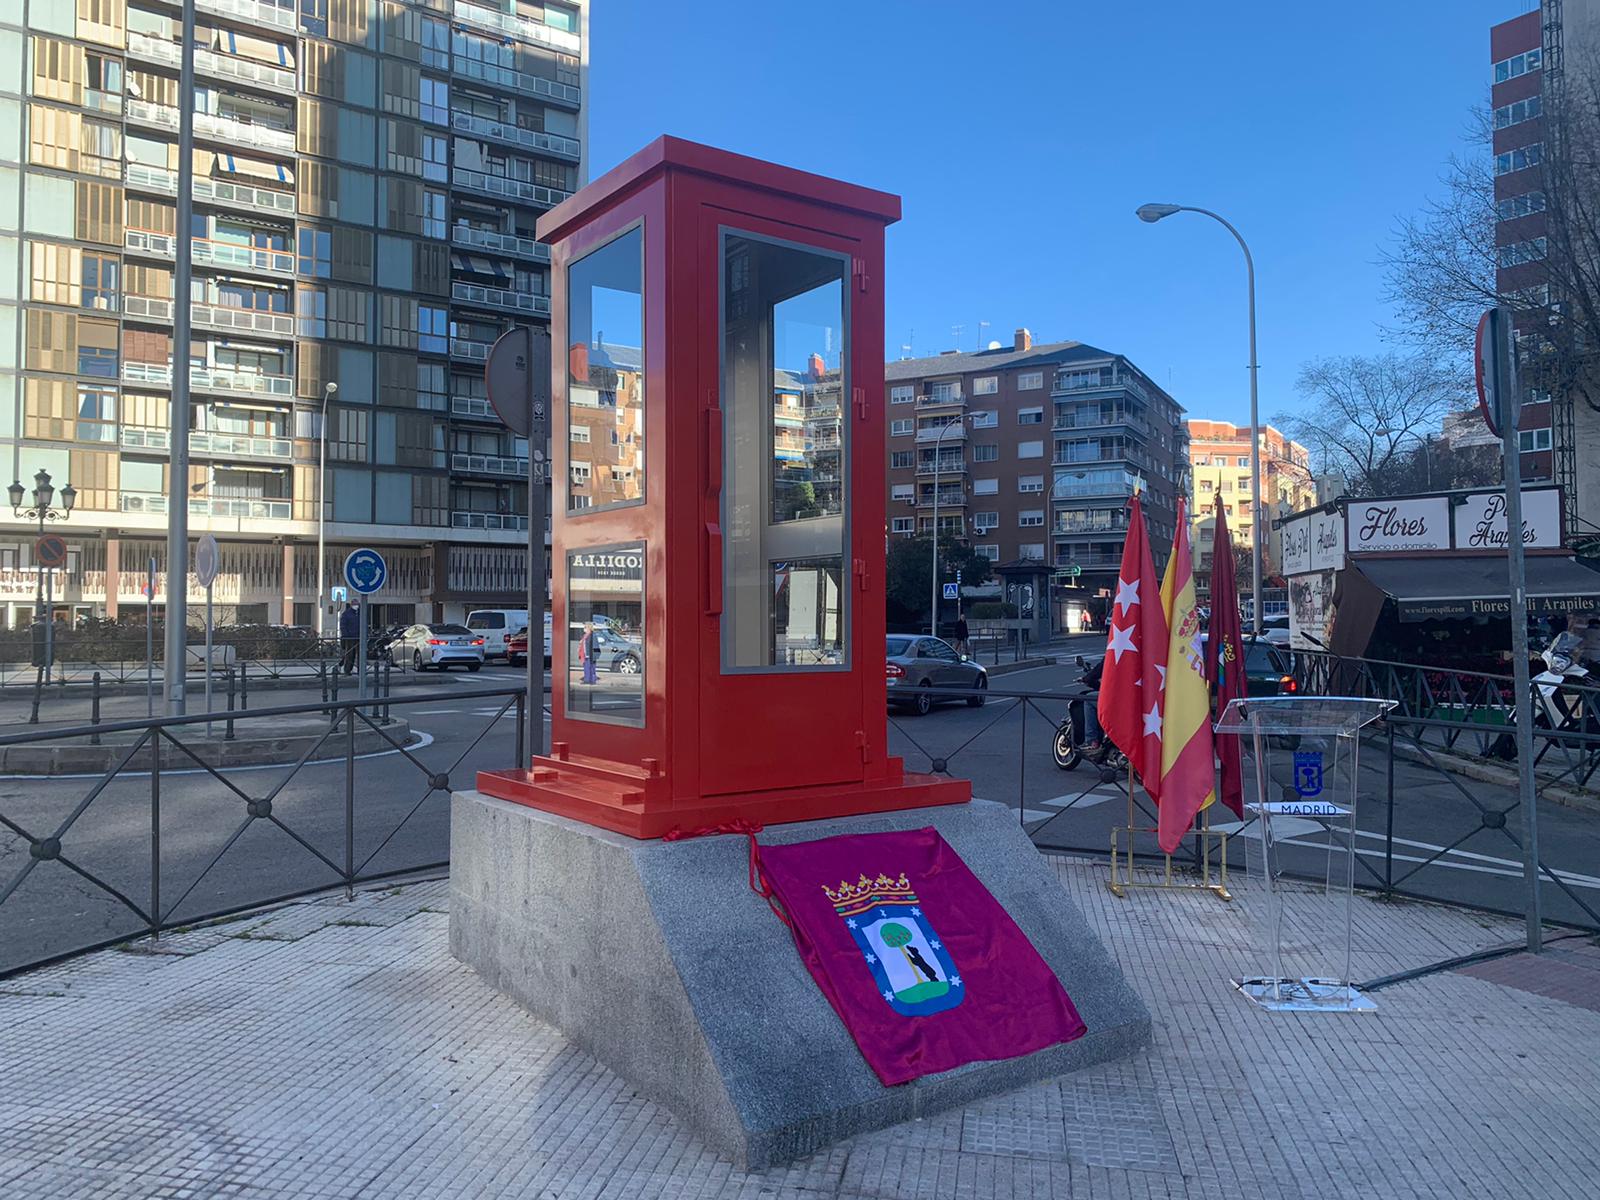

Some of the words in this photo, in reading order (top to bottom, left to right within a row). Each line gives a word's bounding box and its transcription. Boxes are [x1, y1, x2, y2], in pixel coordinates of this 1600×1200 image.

[1360, 507, 1428, 541] Flores
[1469, 520, 1538, 547] Araples
[1472, 600, 1509, 613] Flores
[1543, 597, 1594, 613] Arapiles
[1281, 805, 1337, 815] MADRID
